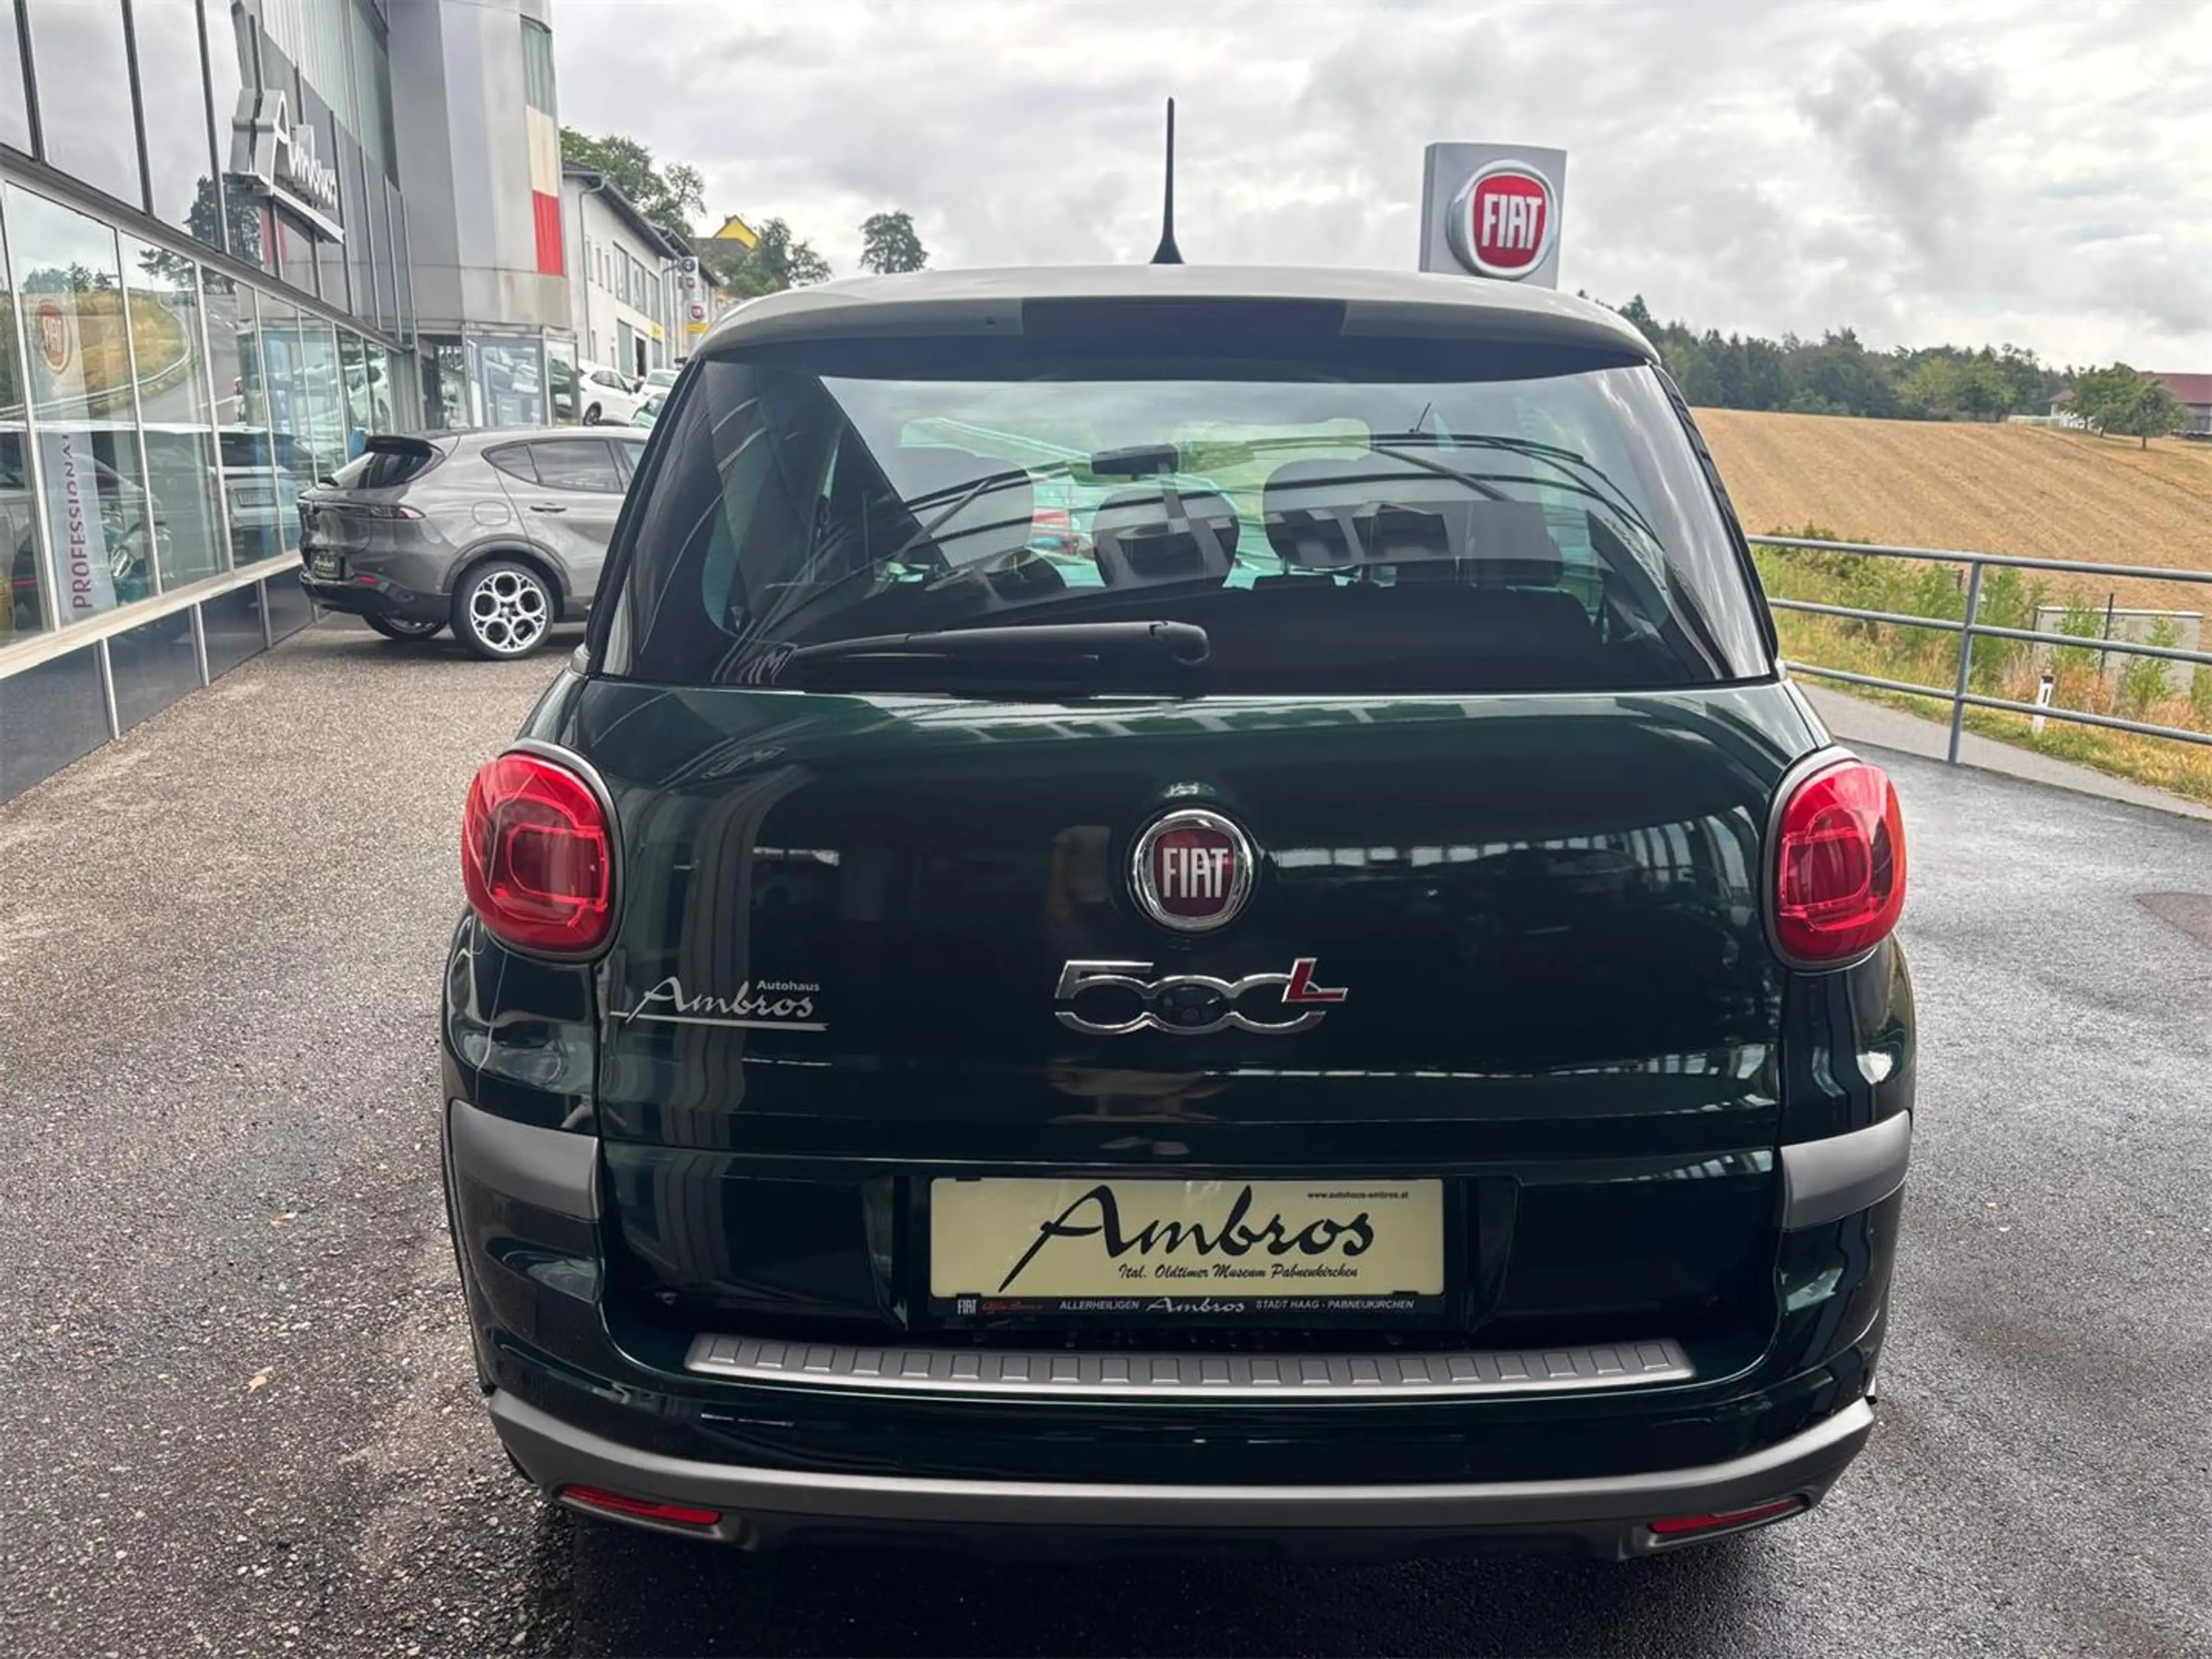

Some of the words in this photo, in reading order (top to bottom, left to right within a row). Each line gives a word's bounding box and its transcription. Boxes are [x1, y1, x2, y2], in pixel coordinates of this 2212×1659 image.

[1481, 193, 1543, 250] FIAT
[1162, 847, 1229, 898] FIAT
[756, 979, 820, 992] Autohaus
[625, 975, 815, 1024] Ambros
[1054, 957, 1349, 1035] 500L
[998, 1184, 1374, 1293] Ambros
[1118, 1263, 1147, 1279] Ital.
[1154, 1264, 1209, 1278] Oldtimer
[1211, 1264, 1266, 1278] Museum
[957, 1299, 977, 1316] FIAT
[1059, 1300, 1140, 1310] ALLERHEILIGEN
[1145, 1297, 1246, 1313] Ambros
[1256, 1300, 1289, 1310] STADT
[1290, 1300, 1320, 1309] HAAG
[1327, 1299, 1414, 1309] PABNEUKIRCHEN
